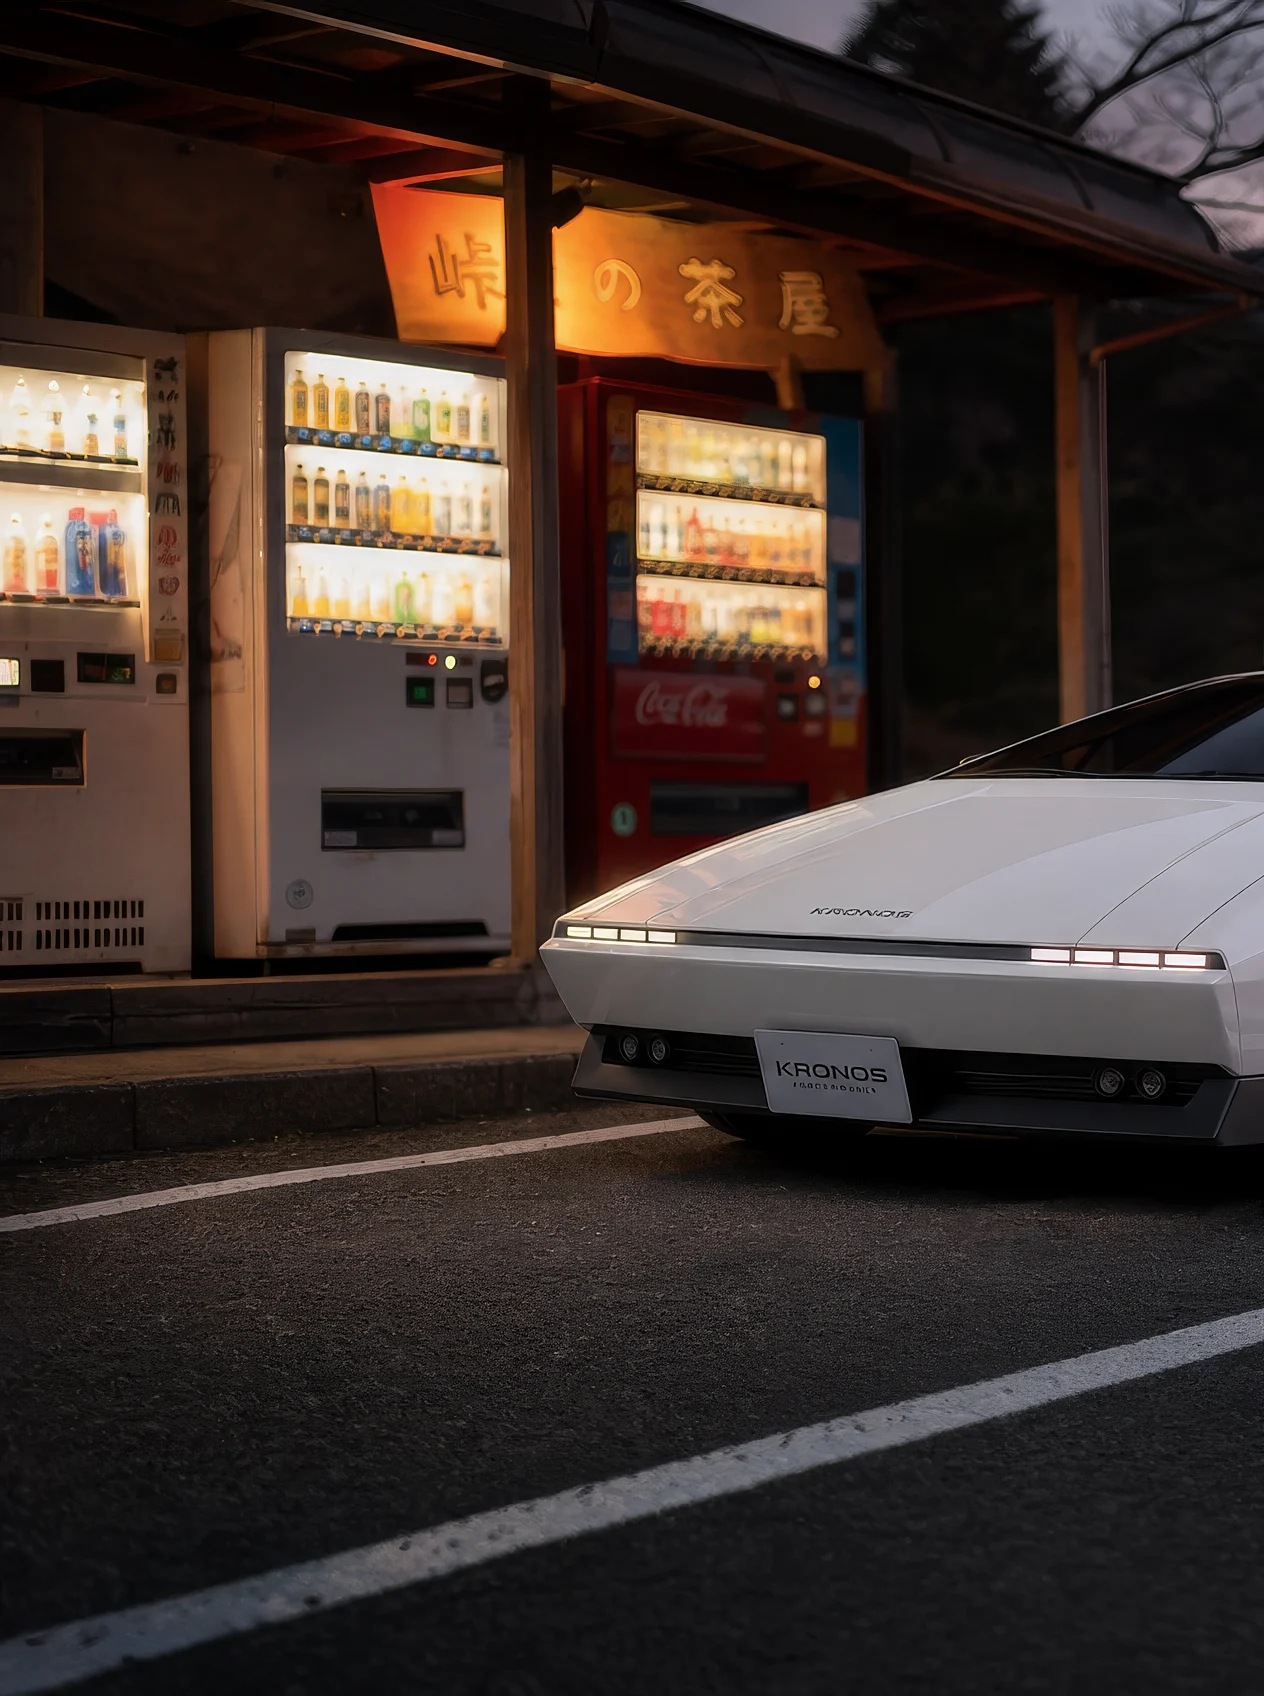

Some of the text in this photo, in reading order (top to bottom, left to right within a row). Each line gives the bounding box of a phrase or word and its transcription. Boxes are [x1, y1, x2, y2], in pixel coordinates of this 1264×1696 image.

[428, 231, 840, 338] 峠の茶屋
[776, 1060, 888, 1083] KRONOS
